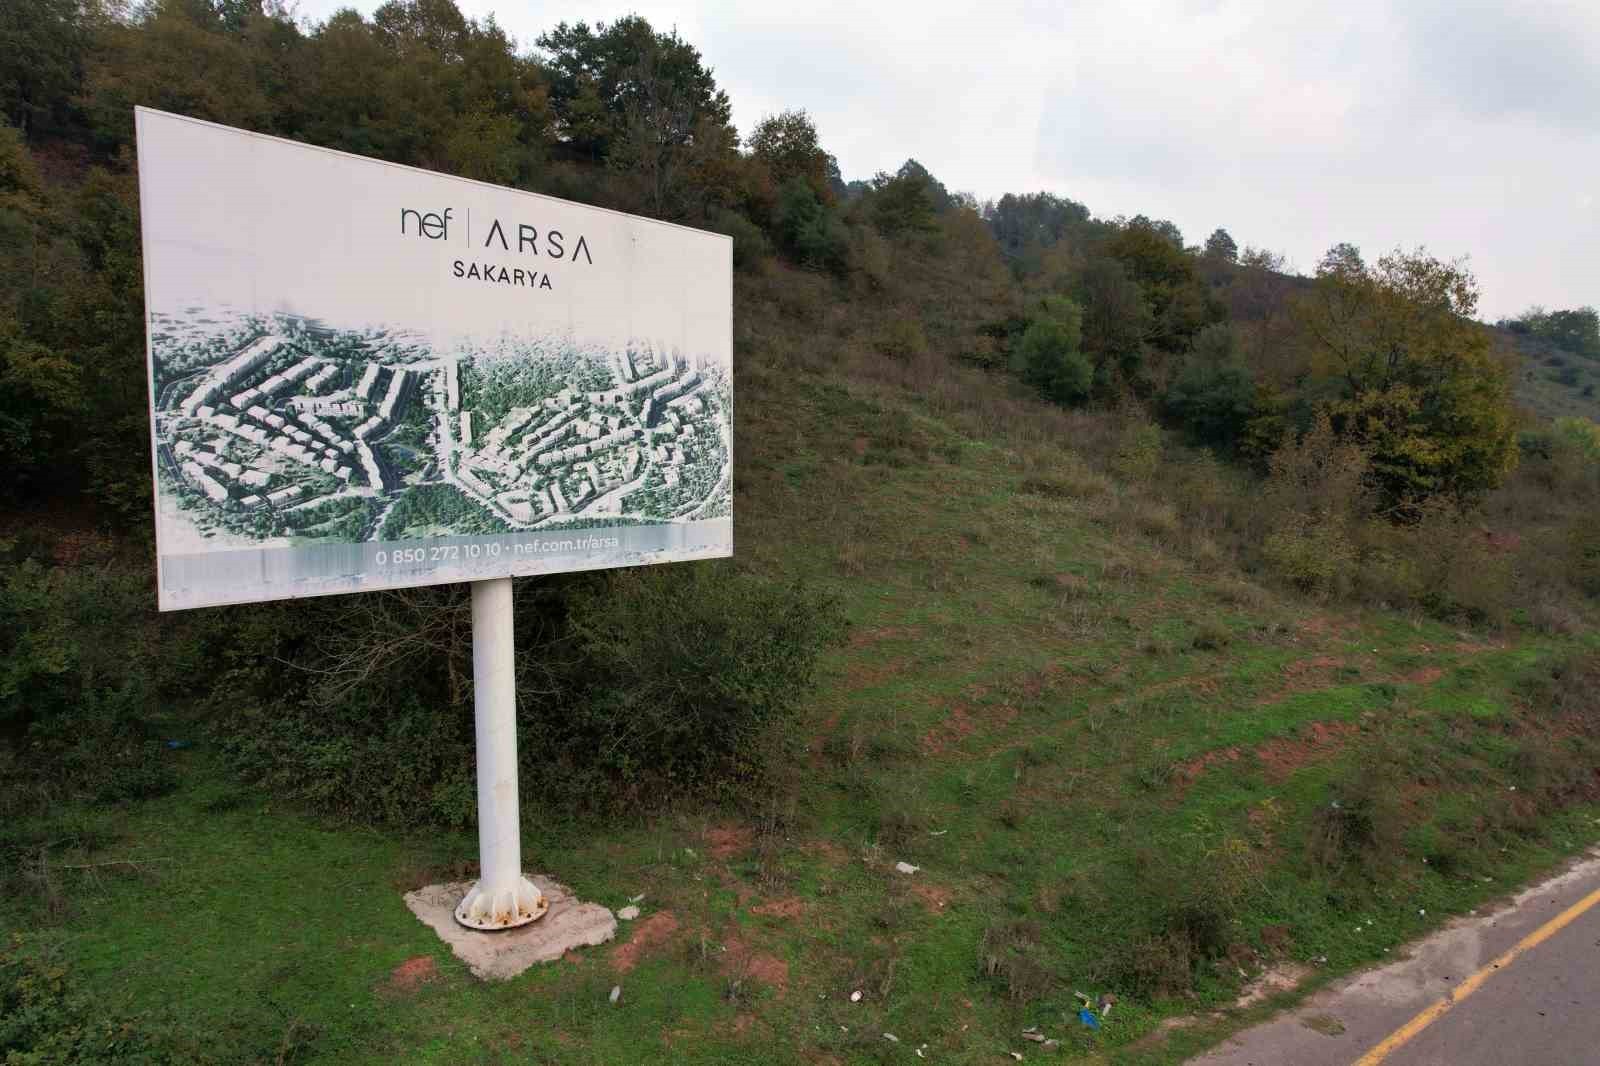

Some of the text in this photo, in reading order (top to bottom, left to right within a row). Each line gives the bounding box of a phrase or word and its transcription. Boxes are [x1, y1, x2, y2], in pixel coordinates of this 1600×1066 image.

[401, 207, 593, 264] nef ARSA
[453, 260, 552, 289] SAKARYA
[375, 534, 619, 565] 0 850 272 10 10 nef.com.tr/arsa
